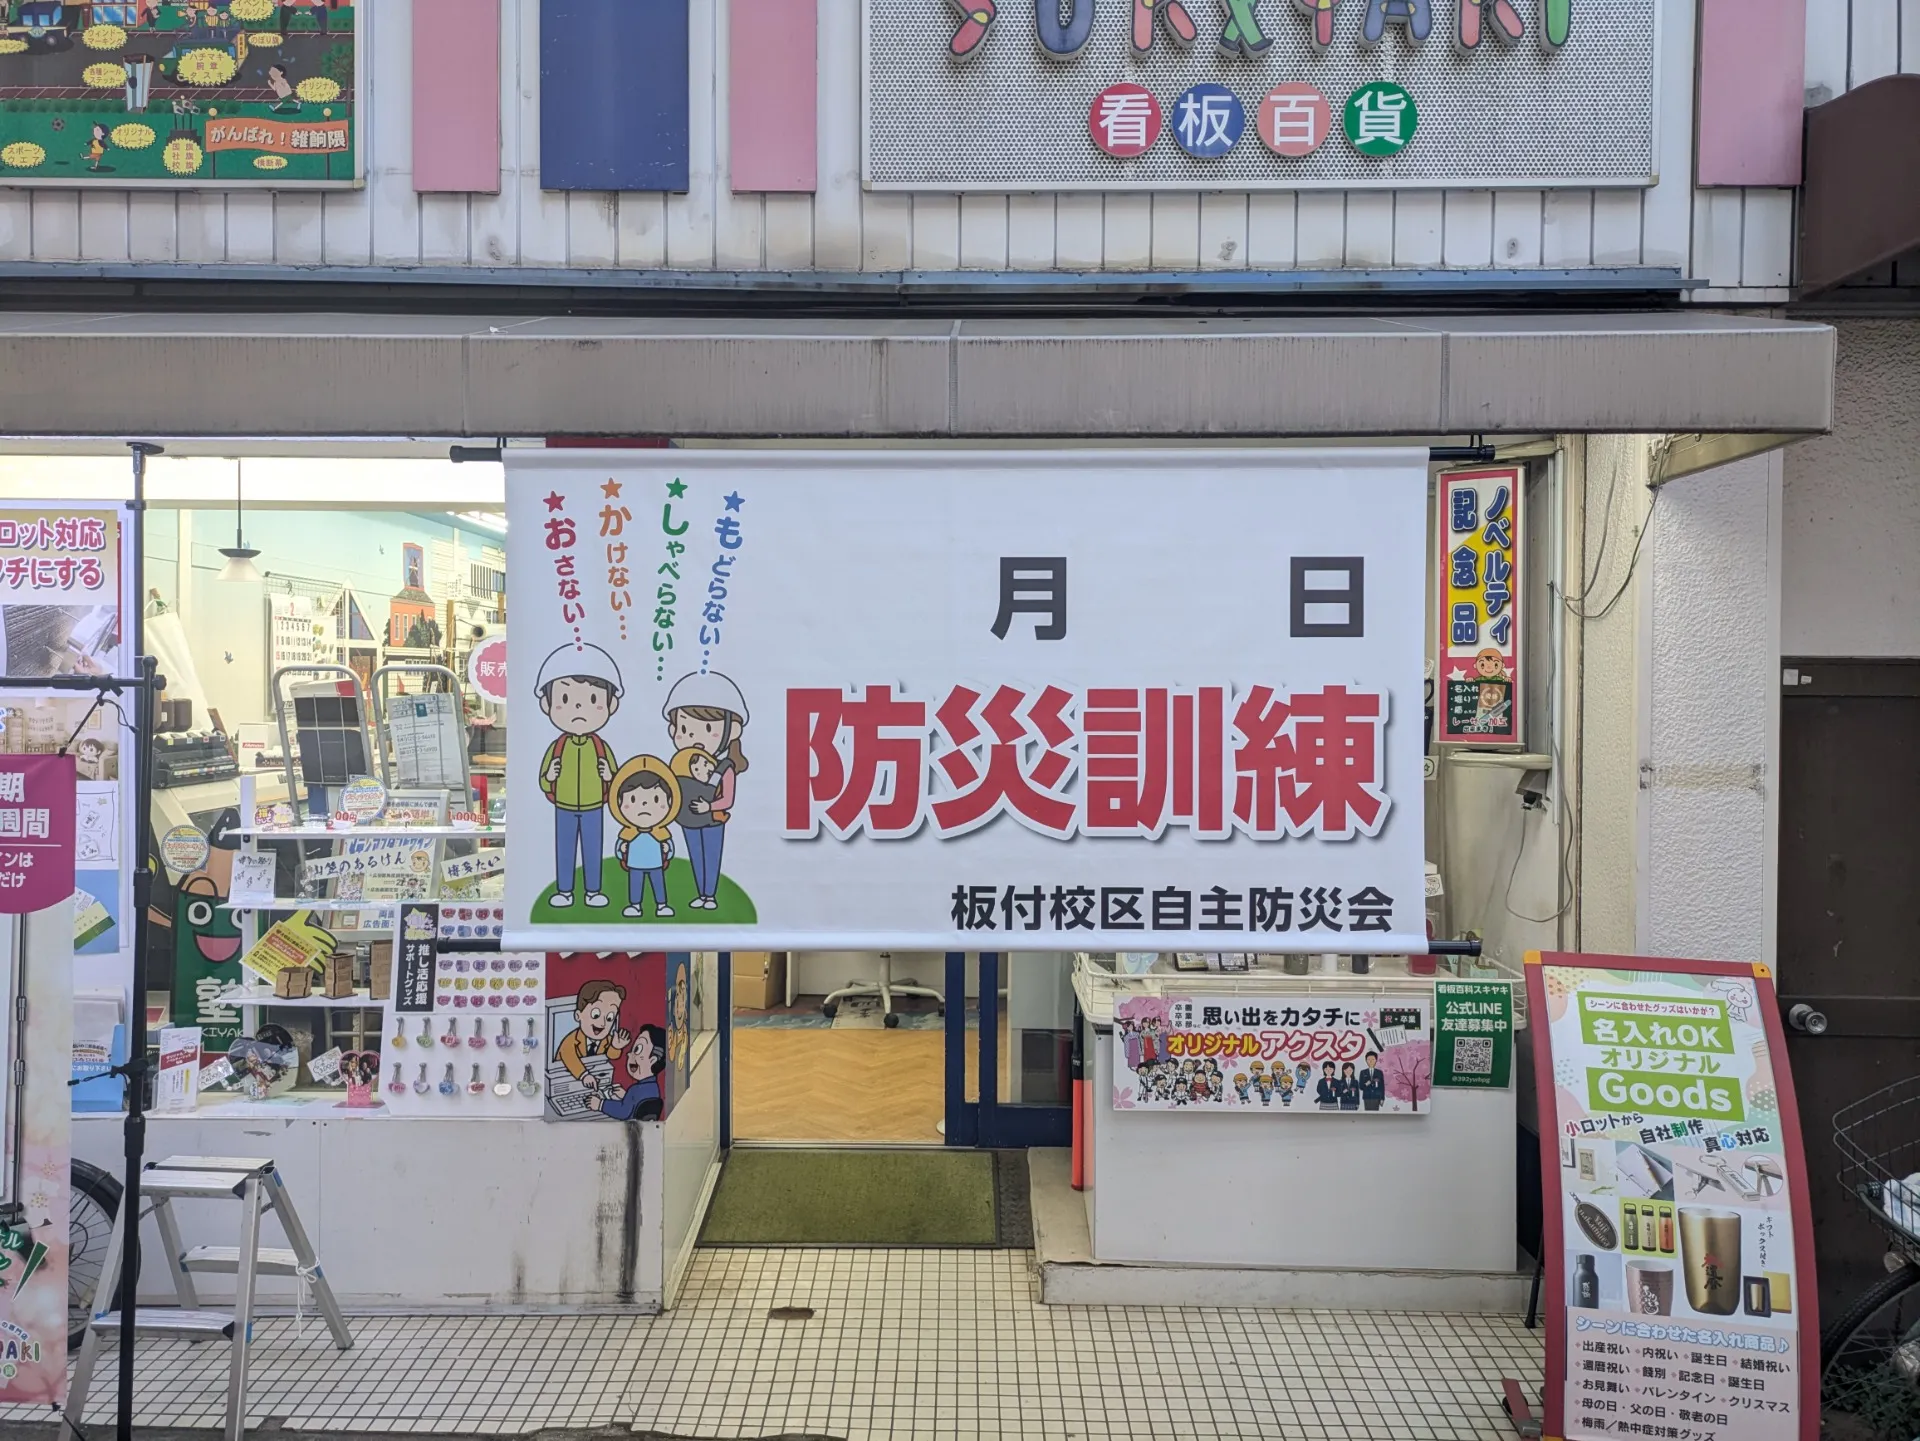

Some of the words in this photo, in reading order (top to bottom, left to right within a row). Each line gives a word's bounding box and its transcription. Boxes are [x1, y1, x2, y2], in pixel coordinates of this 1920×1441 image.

[189, 53, 224, 61] ハチマキ
[1099, 91, 1407, 149] 看板百貨
[0, 557, 102, 588] チにする
[1451, 487, 1477, 644] 記念品
[1483, 486, 1510, 645] ノベルティ
[990, 556, 1068, 641] 月
[1290, 556, 1365, 638] 日
[785, 684, 1385, 833] 防災訓練
[950, 884, 1395, 932] 板付校区自主防災会
[402, 944, 415, 1006] サポートグッズ
[414, 944, 430, 1005] 推し活応援
[1438, 984, 1508, 995] 看板百科スキヤキ
[1203, 1006, 1360, 1026] 思い出をカタチに
[1446, 1001, 1502, 1016] 公式LINE
[1590, 1000, 1716, 1017] シーンに合わせたグッズはいかが？
[1441, 1018, 1508, 1032] 友達募集中
[1593, 1018, 1723, 1048] 名入れOK
[1600, 1048, 1721, 1074] オリジナル
[1598, 1072, 1733, 1112] Goods
[1565, 1112, 1645, 1138] 小ロットから
[1640, 1118, 1704, 1144] 自社制作
[1702, 1127, 1771, 1154] 真心対応
[1582, 1340, 1630, 1354] 出産祝い
[1642, 1347, 1678, 1360] 内祝い
[1691, 1352, 1728, 1367] 誕生日
[1740, 1358, 1790, 1374] 結婚祝い
[1582, 1360, 1630, 1374] 還暦祝い
[1678, 1370, 1715, 1385] 記念日
[1728, 1376, 1765, 1392] 誕生日
[1582, 1379, 1630, 1394] お見舞い
[1642, 1386, 1716, 1404] バレンタイン
[1728, 1396, 1790, 1414] クリスマス
